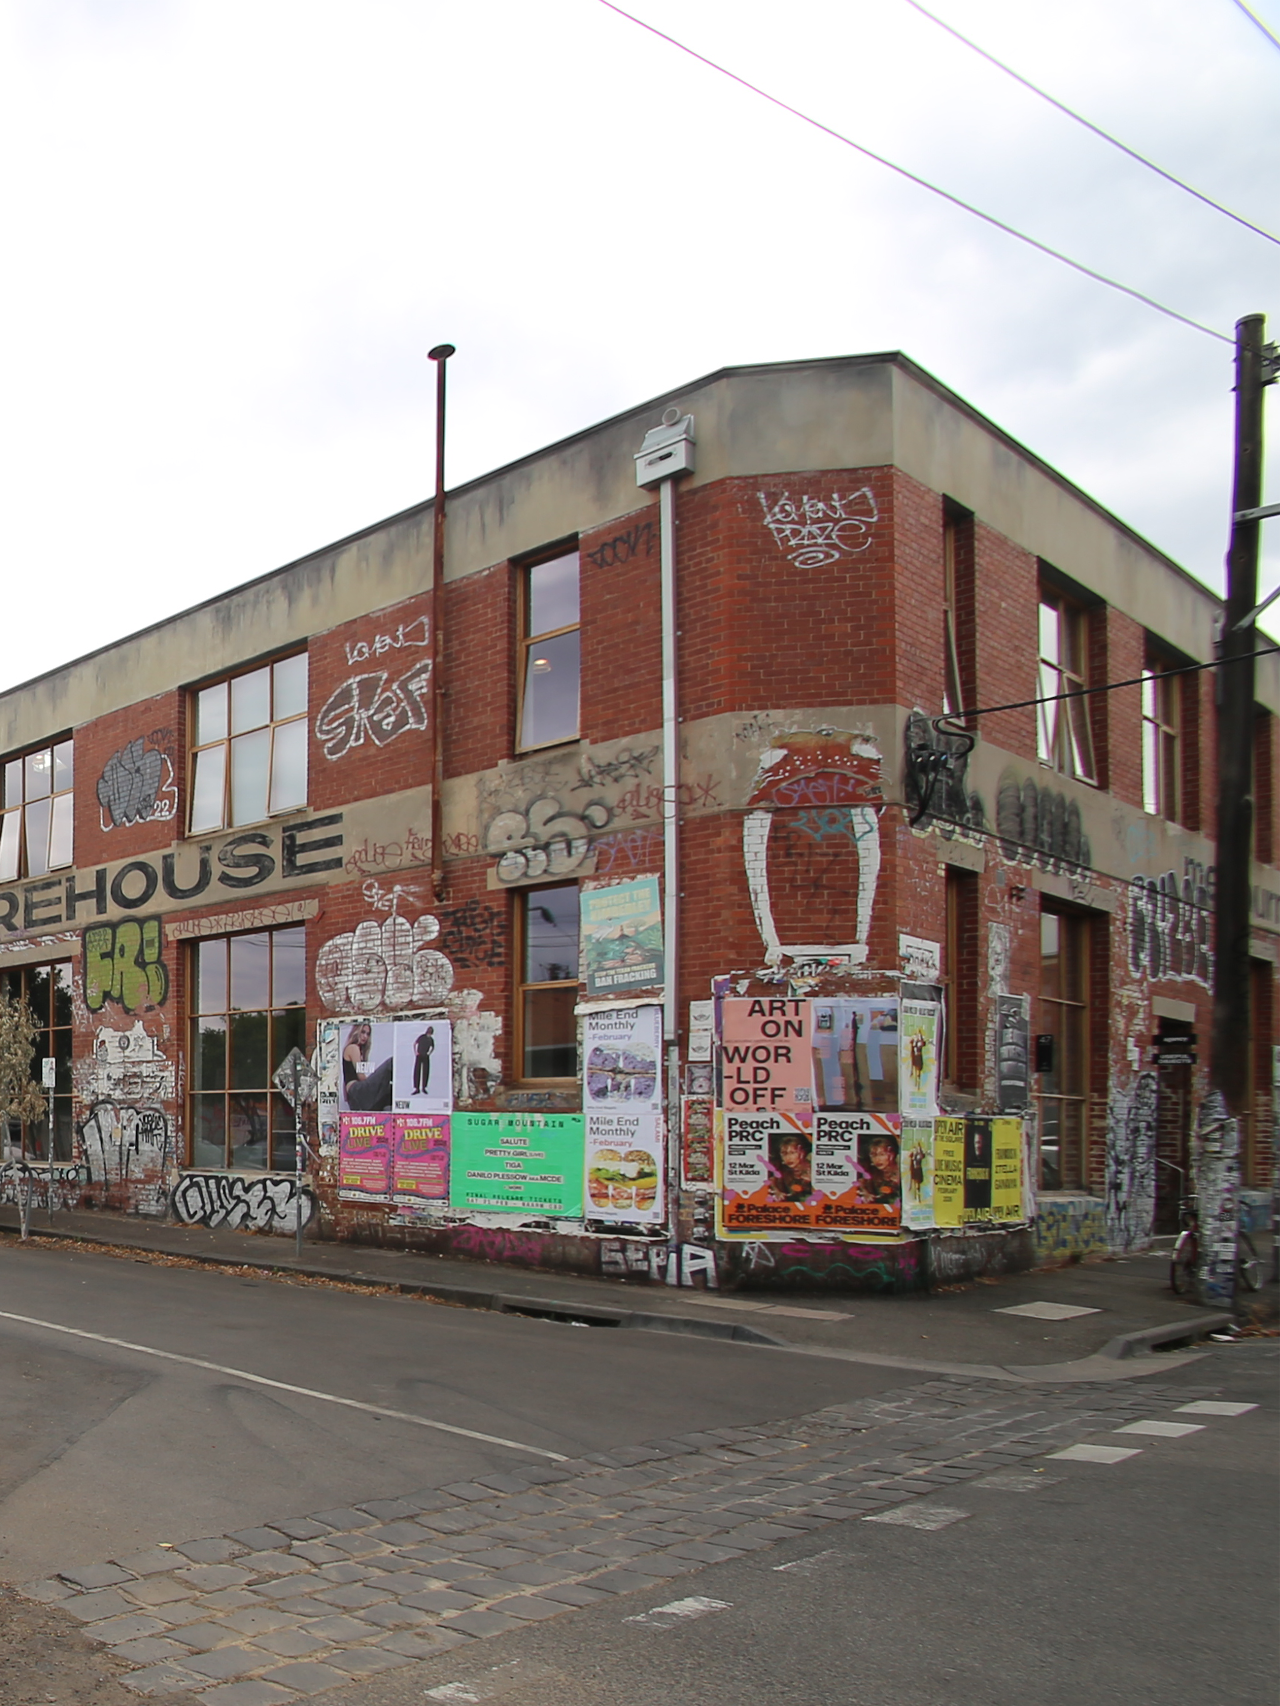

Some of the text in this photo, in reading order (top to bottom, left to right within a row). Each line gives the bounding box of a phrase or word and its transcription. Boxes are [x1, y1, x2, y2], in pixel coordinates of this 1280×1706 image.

[595, 969, 657, 987] BAN FRACKING
[748, 999, 807, 1017] ART
[616, 1010, 638, 1019] End
[588, 1020, 635, 1031] Monthly
[761, 1020, 803, 1038] ON
[723, 1046, 792, 1064] WOR
[723, 1066, 771, 1084] -LD
[729, 1087, 787, 1105] OFF
[467, 1118, 564, 1128] SUGAR MOUNTAIN
[589, 1117, 639, 1126] Mile End
[728, 1117, 780, 1130] Peach
[816, 1117, 870, 1131] Peach
[349, 1125, 384, 1138] DRIVE
[404, 1128, 443, 1140] DRIVE
[589, 1127, 636, 1138] Monthly
[948, 1121, 963, 1136] AIR
[500, 1138, 528, 1146] SALUTE
[728, 1130, 764, 1142] PRC
[816, 1130, 853, 1142] PRC
[347, 1138, 371, 1148] LIVE
[402, 1140, 428, 1151] LIVE
[484, 1149, 511, 1157] PRETTY
[947, 1160, 962, 1172] MUSIC
[467, 1171, 492, 1179] DANILO
[493, 1173, 528, 1181] PLESSOW
[540, 1175, 562, 1183] MCDE
[934, 1174, 963, 1186] CINEMA
[747, 1203, 791, 1214] Palace
[835, 1205, 879, 1216] Palace
[1005, 1205, 1020, 1218] AIR
[728, 1214, 811, 1224] FORESHORE
[815, 1215, 898, 1226] FORESHORE
